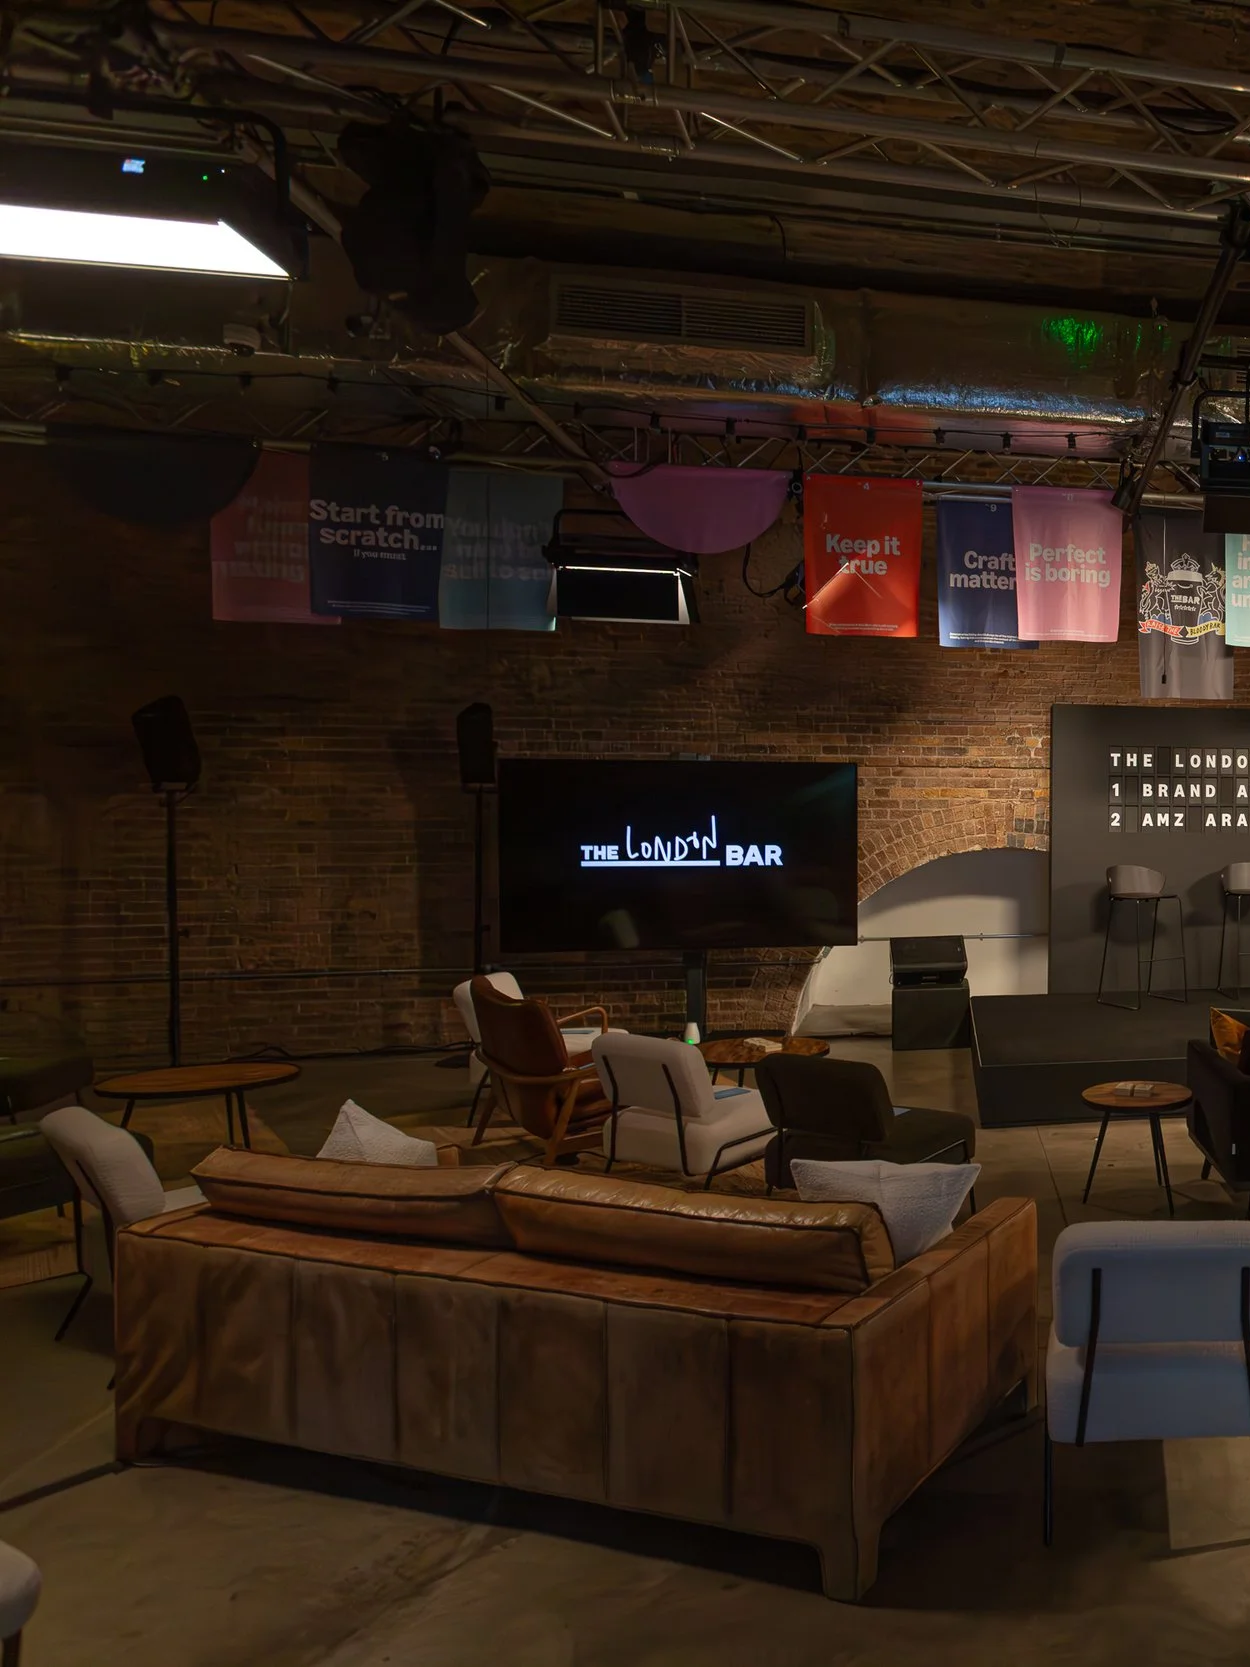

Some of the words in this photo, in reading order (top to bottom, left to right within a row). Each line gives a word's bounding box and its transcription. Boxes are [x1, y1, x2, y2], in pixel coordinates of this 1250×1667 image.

[309, 499, 380, 525] Start
[385, 505, 444, 529] from
[319, 527, 437, 551] scratch...
[826, 534, 880, 557] Keep
[884, 536, 900, 556] it
[361, 550, 378, 560] you
[964, 551, 1016, 570] Craft
[1029, 543, 1106, 564] Perfect
[838, 555, 888, 576] true
[1025, 562, 1042, 581] is
[1045, 563, 1111, 588] boring
[950, 571, 1016, 590] matter
[1182, 596, 1200, 605] BAR
[1190, 625, 1209, 635] BLOODY
[1209, 622, 1221, 630] BAR
[1110, 753, 1153, 768] THE
[1112, 783, 1119, 797] 1
[1143, 783, 1216, 798] BRAND
[1110, 812, 1121, 827] 2
[1142, 813, 1184, 827] AMZ
[581, 845, 619, 860] THE
[626, 815, 717, 861] LONDON
[725, 845, 783, 866] BAR
